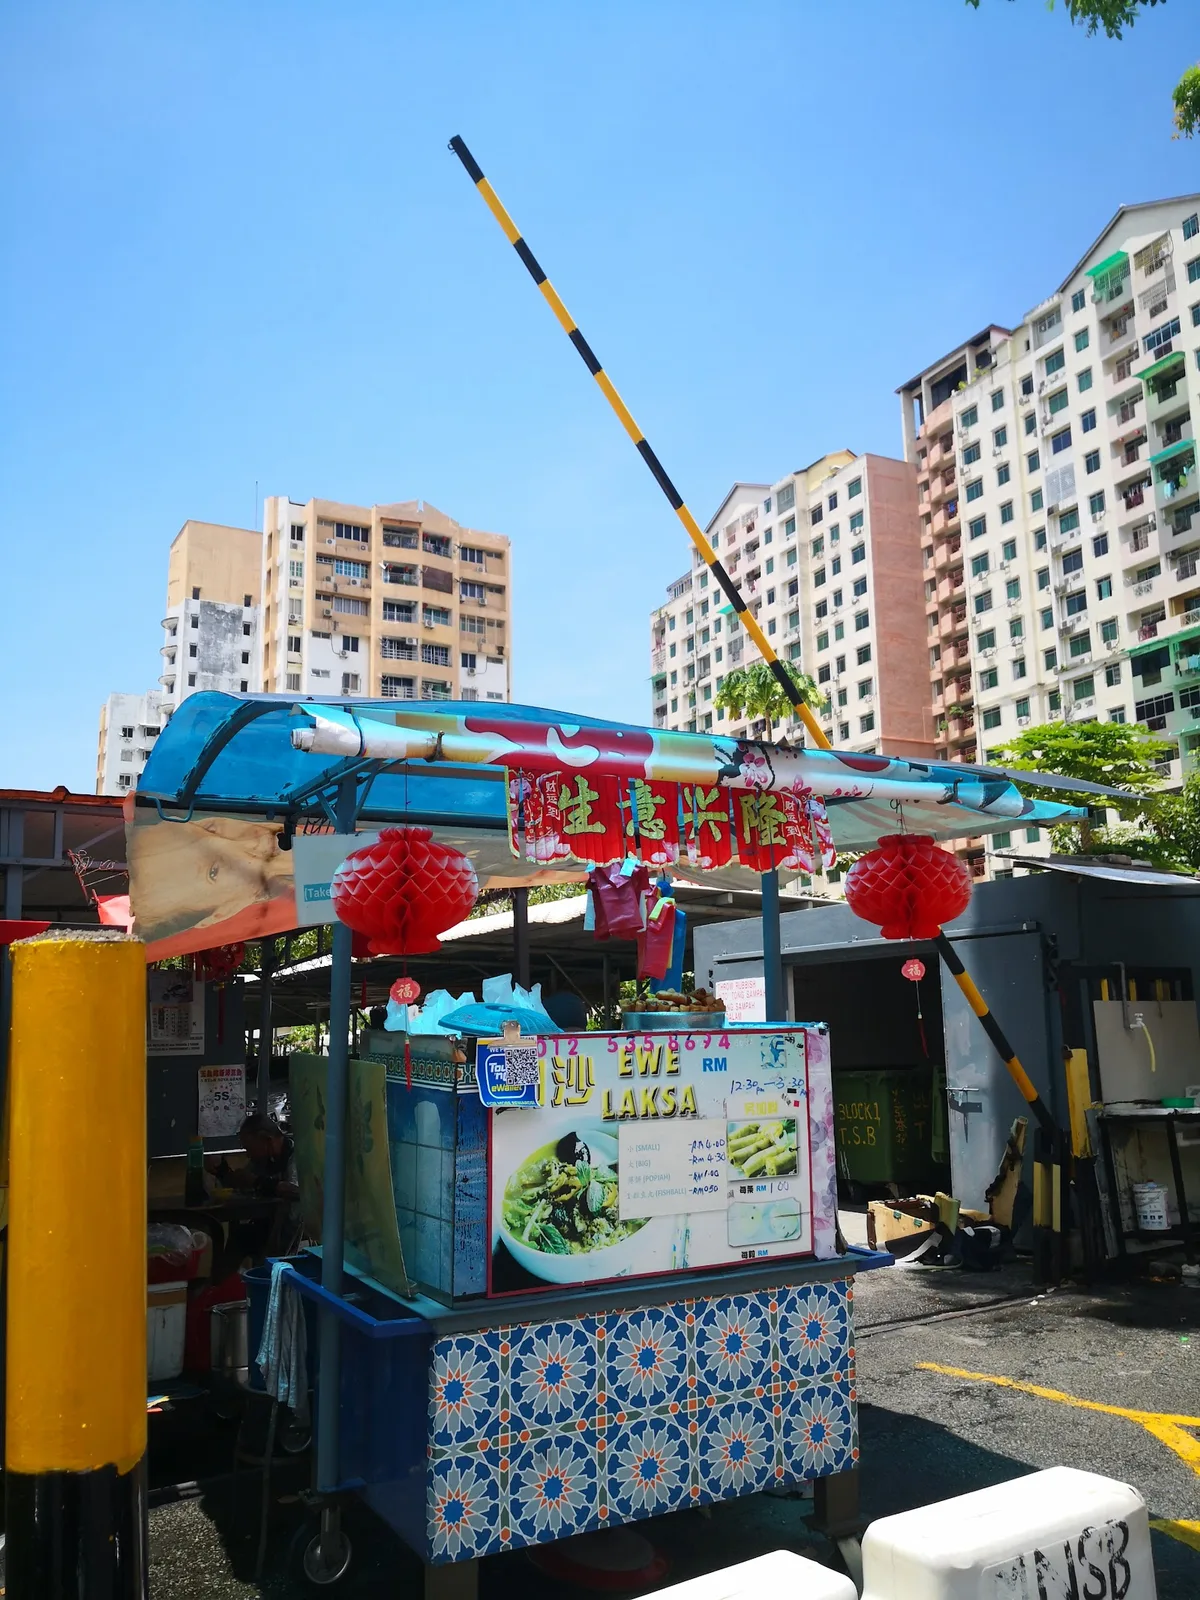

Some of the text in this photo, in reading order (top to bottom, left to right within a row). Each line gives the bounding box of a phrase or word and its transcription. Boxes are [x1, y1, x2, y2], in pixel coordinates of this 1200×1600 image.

[558, 774, 788, 847] 生意兴隆
[784, 800, 801, 837] 财运到
[906, 963, 921, 977] 福
[396, 983, 414, 999] 福
[736, 980, 757, 990] RUBBISH
[537, 1037, 579, 1058] 012
[617, 1043, 681, 1079] EWE
[702, 1057, 728, 1073] RM
[537, 1054, 596, 1108] 沙
[213, 1091, 230, 1101] 5S
[601, 1083, 700, 1122] LAKSA
[755, 1184, 767, 1192] RM
[757, 1249, 769, 1257] RM
